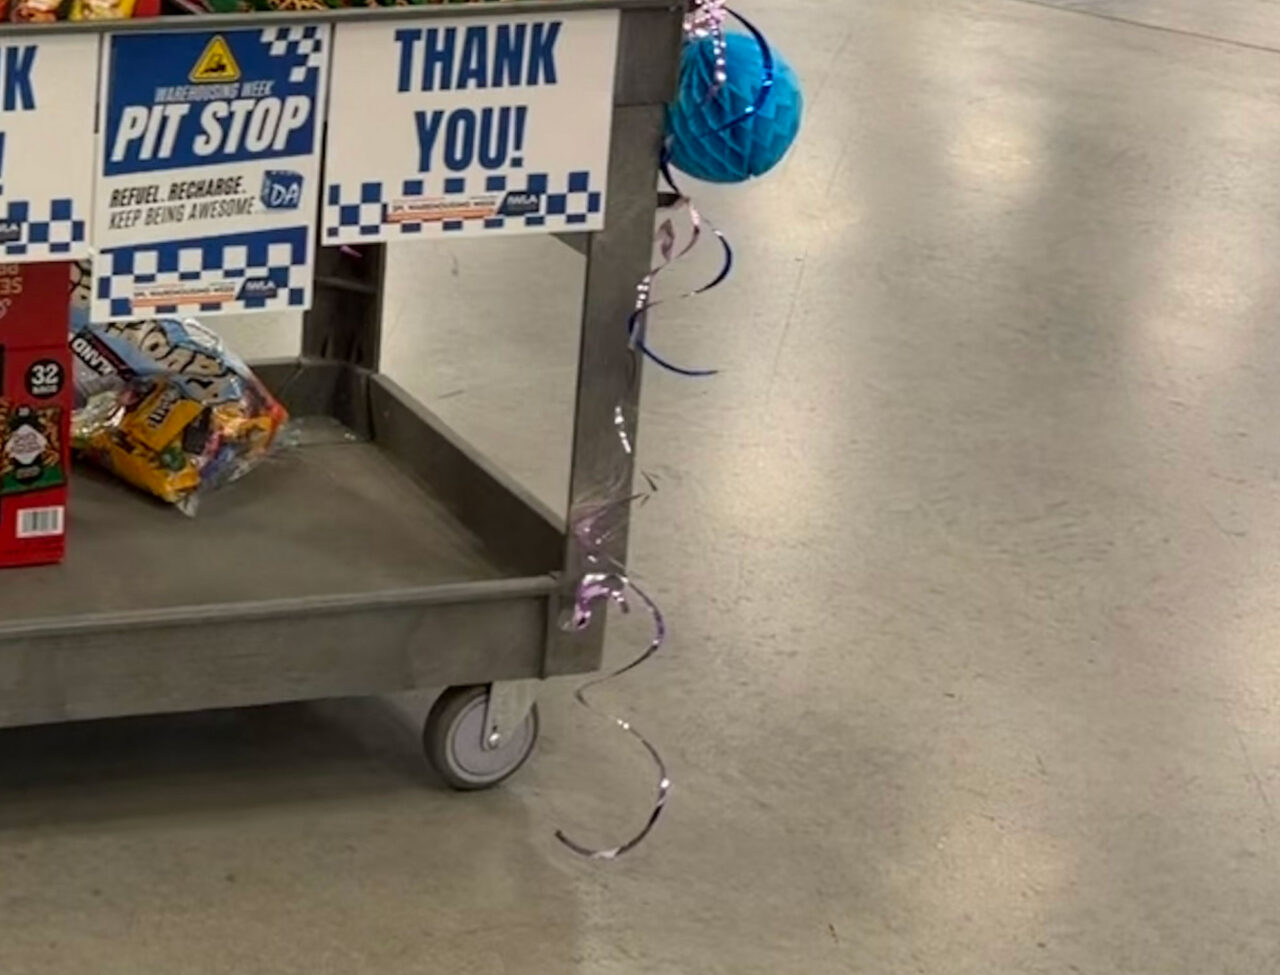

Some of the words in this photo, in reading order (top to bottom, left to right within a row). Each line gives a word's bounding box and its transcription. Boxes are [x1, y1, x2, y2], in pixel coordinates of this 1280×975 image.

[394, 22, 562, 92] THANK
[155, 83, 240, 102] WAREHOUSING
[241, 80, 275, 97] WEEK
[110, 103, 190, 162] PIT
[193, 95, 310, 156] STOP
[414, 106, 527, 172] YOU!
[109, 184, 165, 208] REFUEL.
[168, 176, 246, 202] RECHARGE.
[109, 211, 141, 230] KEEP
[144, 205, 184, 226] BEING
[32, 363, 59, 384] 32
